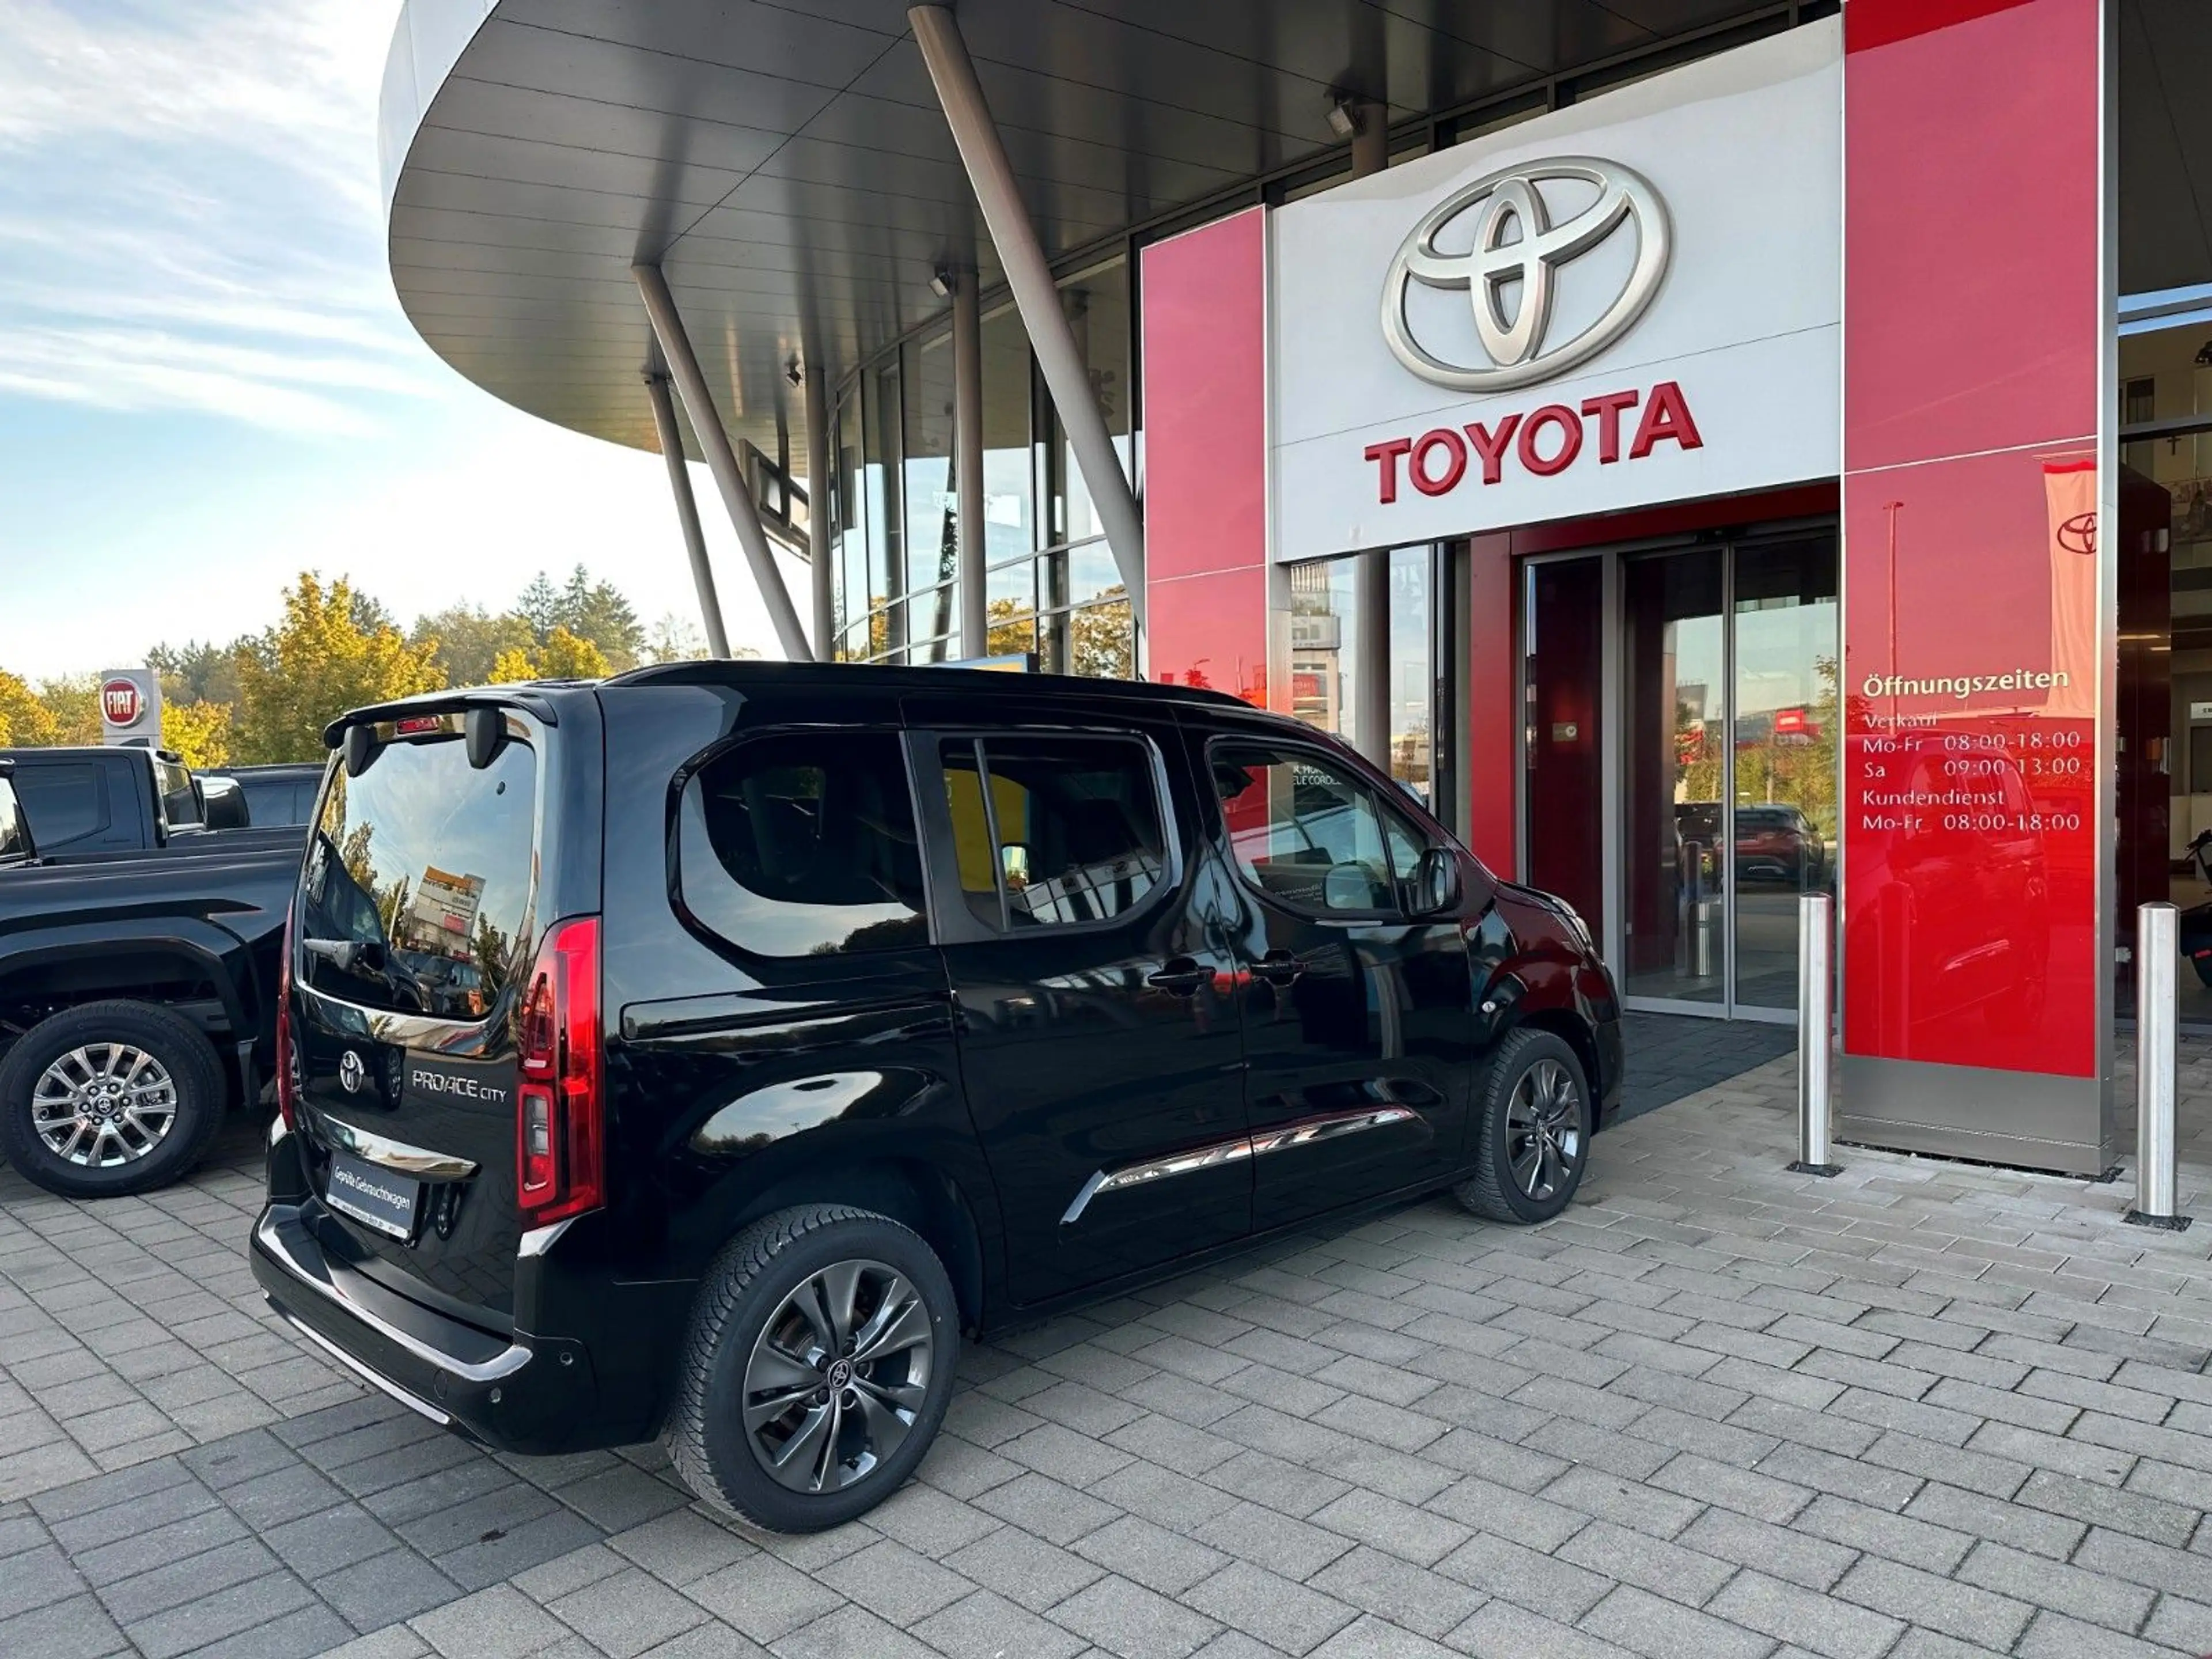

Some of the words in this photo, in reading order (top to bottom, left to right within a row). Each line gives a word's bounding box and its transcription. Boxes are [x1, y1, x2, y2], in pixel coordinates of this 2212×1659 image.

[1364, 381, 1703, 503] TOYOTA
[1863, 669, 2069, 699] Öffnungszeiten
[106, 691, 133, 714] FIAT
[1863, 711, 1938, 729] Verkauf
[1863, 737, 1922, 753] Mo-Fr
[1944, 730, 2080, 751] 08:00-18:00
[1864, 761, 1886, 778] Sa
[1863, 788, 2005, 805] Kundendienst
[1863, 815, 1922, 830] Mo-Fr
[1944, 813, 2080, 831] 08:00-18:00
[412, 1070, 478, 1097] PROACE
[479, 1088, 507, 1103] CITY
